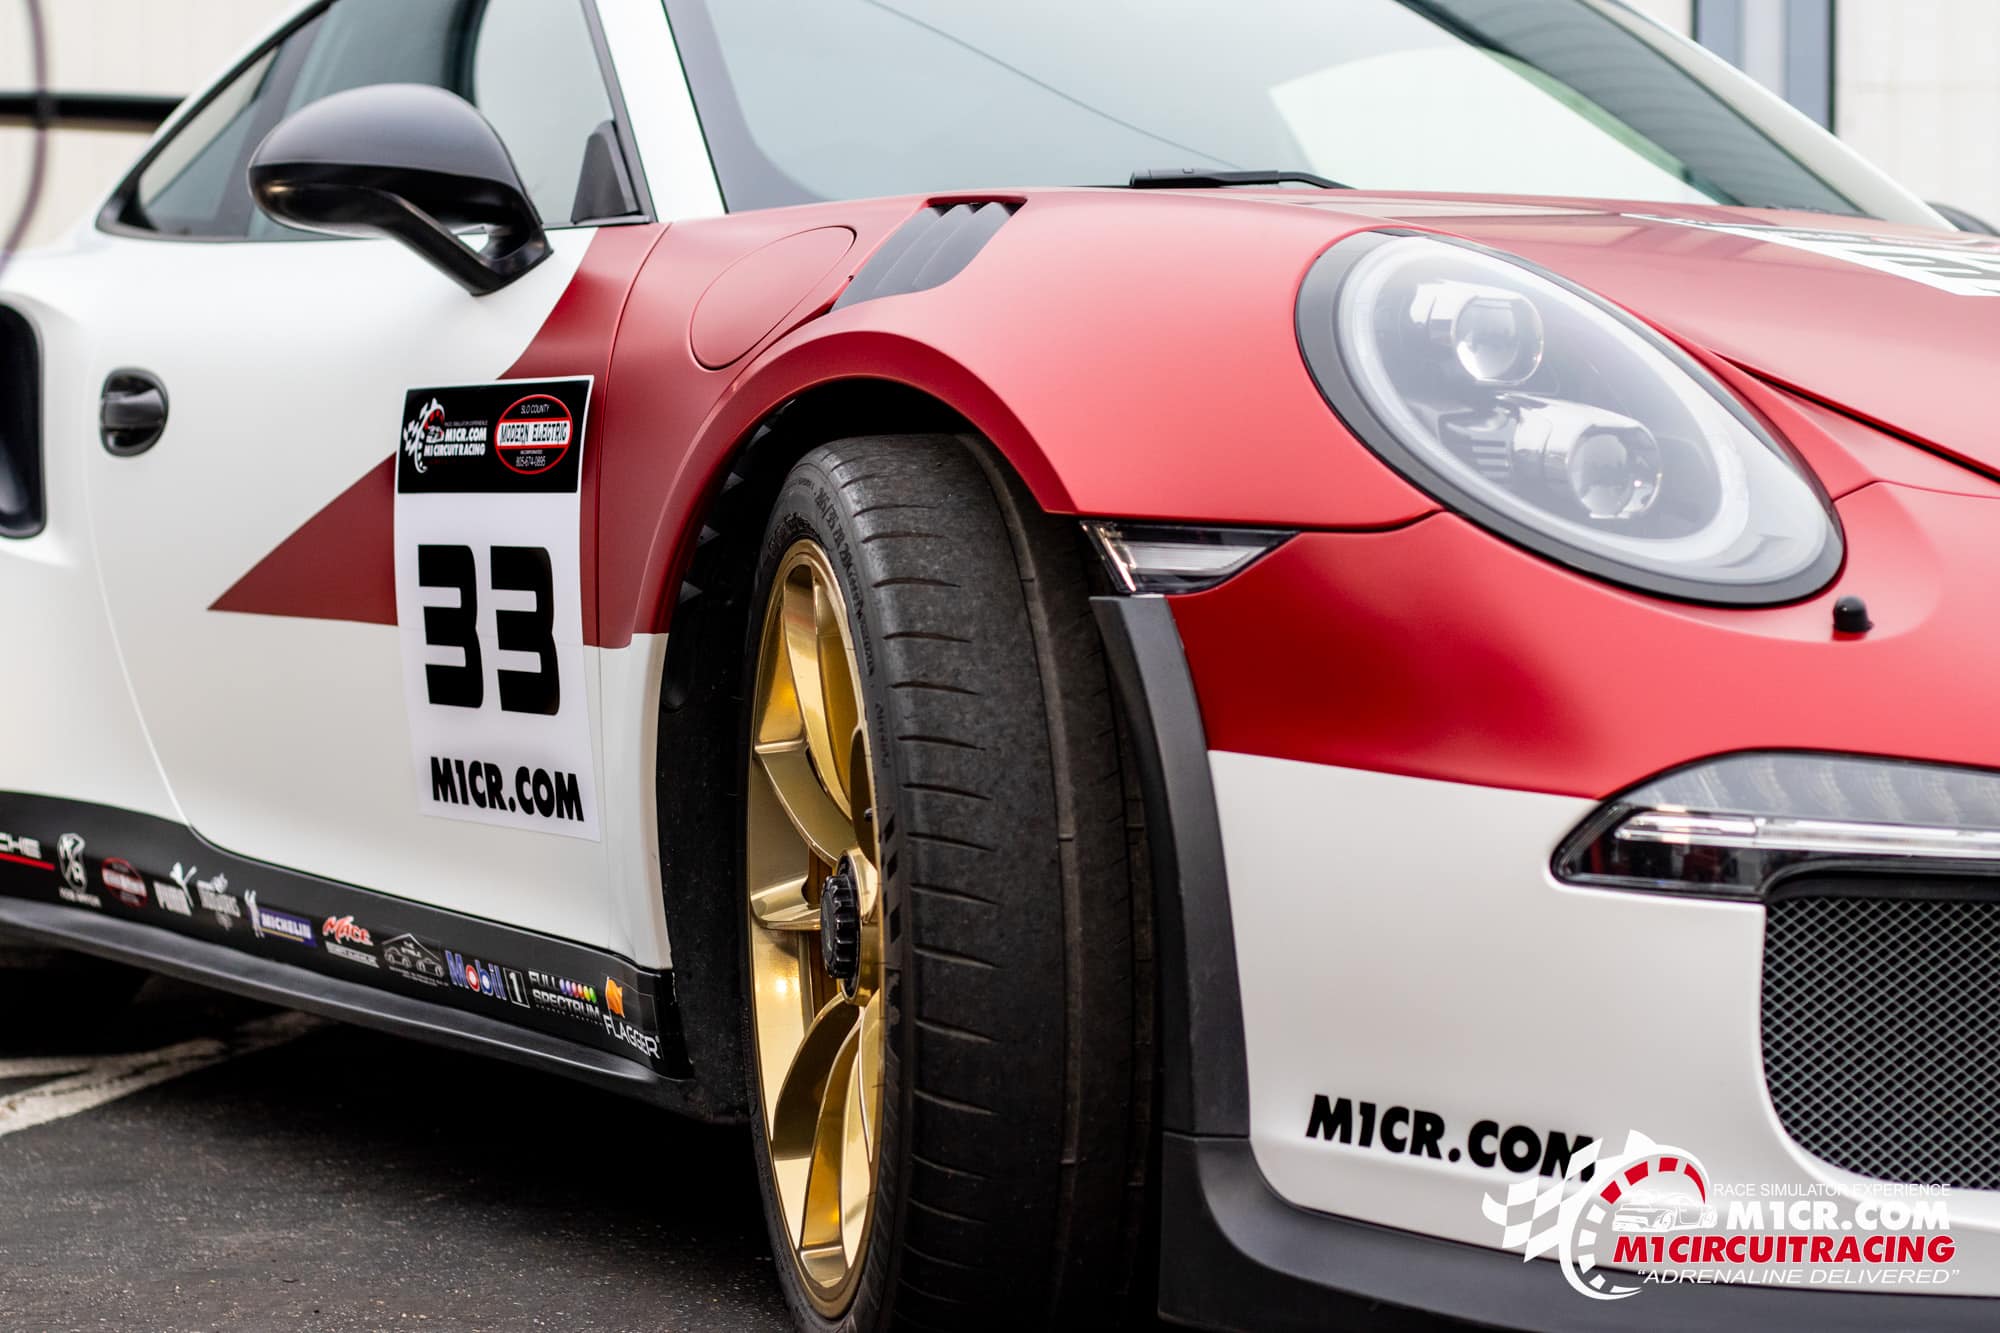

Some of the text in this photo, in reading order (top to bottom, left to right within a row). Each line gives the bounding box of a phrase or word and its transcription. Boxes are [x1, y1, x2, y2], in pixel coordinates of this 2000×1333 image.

[500, 422, 568, 444] MODERN ELECTRIC
[418, 544, 560, 716] 33
[430, 756, 585, 822] M1CR.COM
[261, 912, 313, 940] MICHELIN
[445, 950, 507, 1001] Mobil
[509, 971, 523, 1004] 1
[528, 970, 560, 990] FULL
[532, 988, 601, 1019] SPECTRUM
[1305, 1094, 1596, 1182] M1CR.COM
